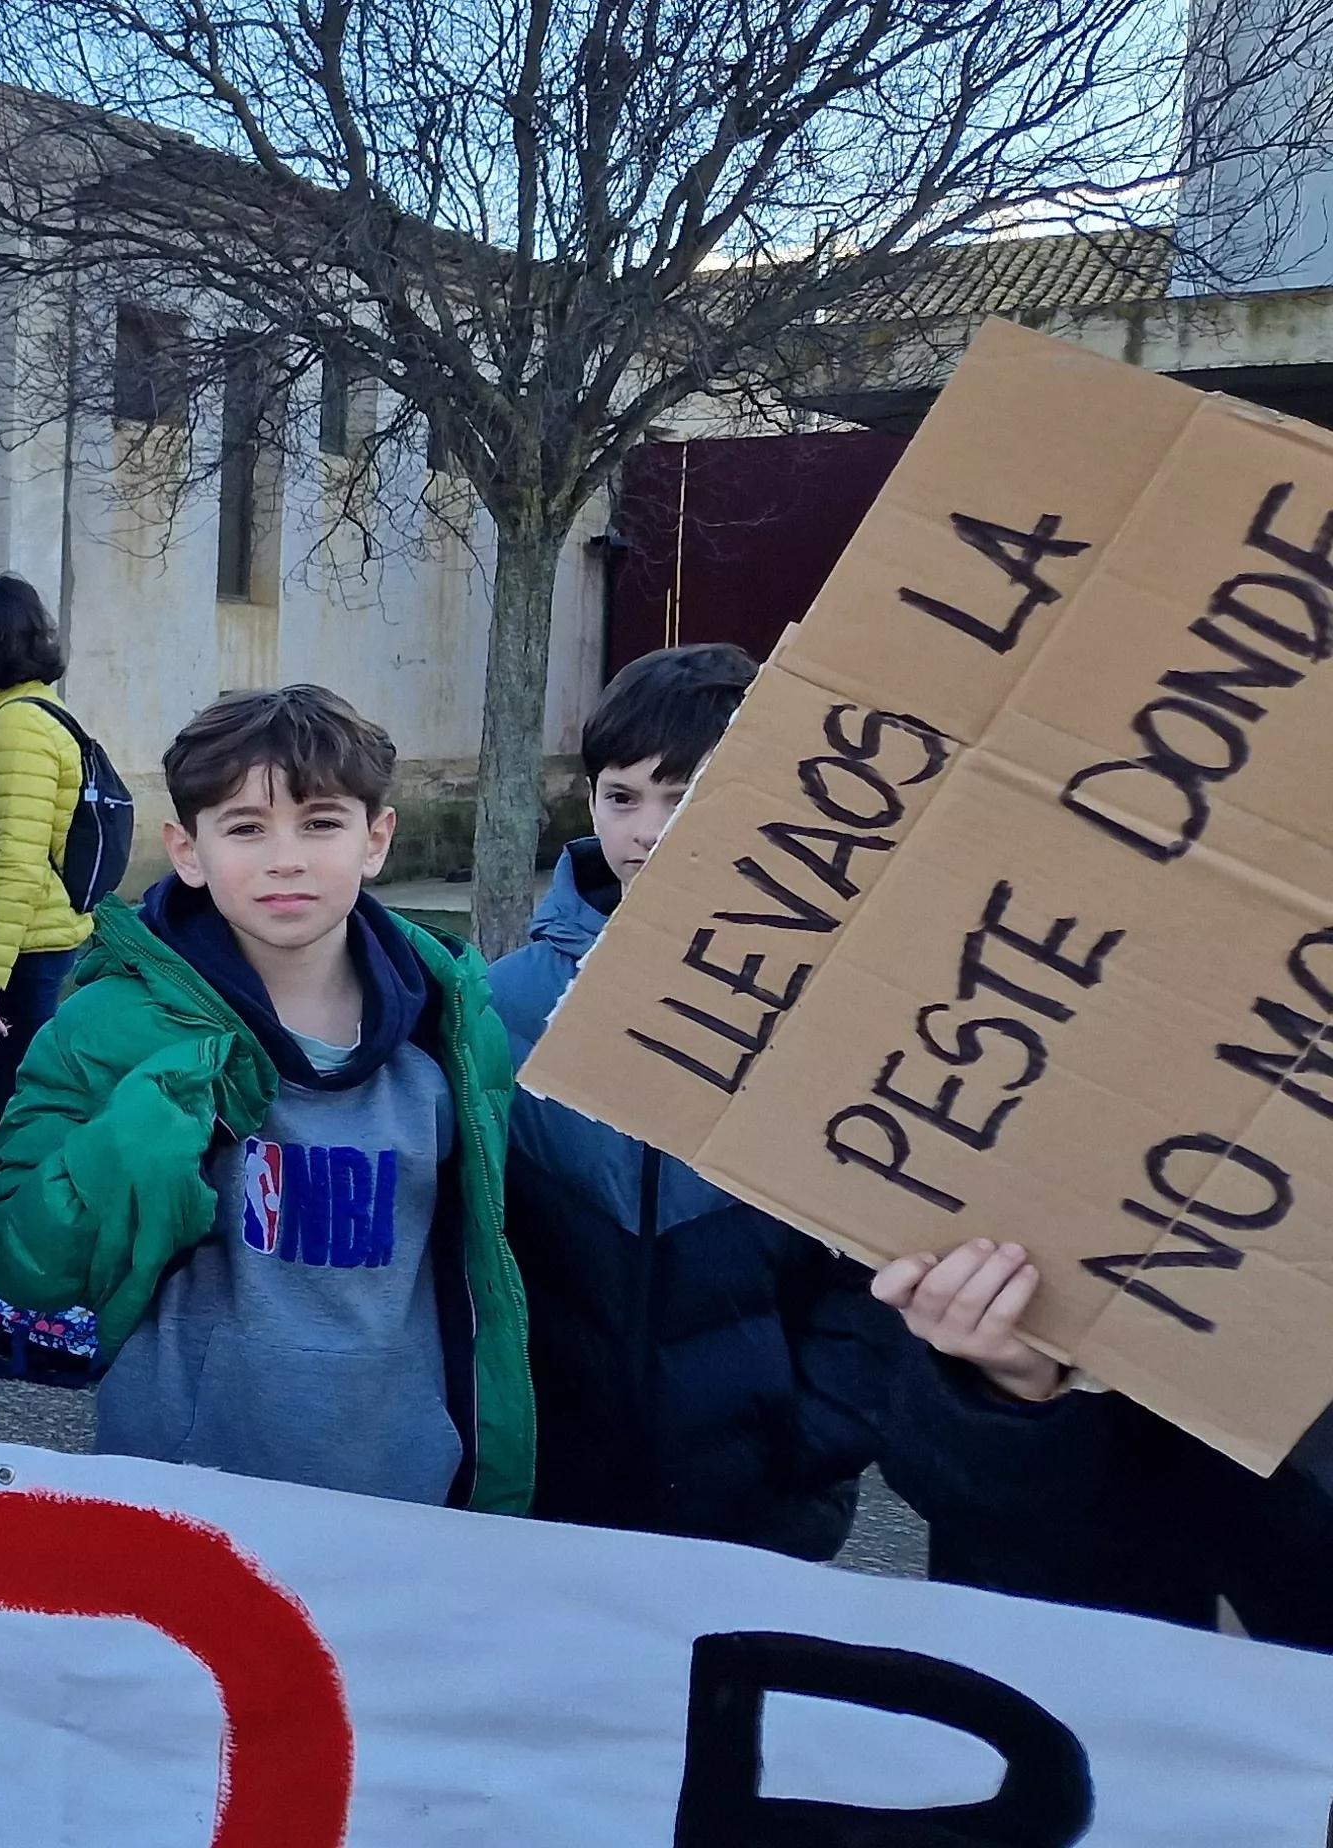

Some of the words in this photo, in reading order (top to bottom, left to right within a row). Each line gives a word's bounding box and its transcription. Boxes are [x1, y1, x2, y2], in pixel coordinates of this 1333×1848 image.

[625, 701, 950, 1095] LLEVAOS
[899, 512, 1092, 655] LA
[824, 879, 1127, 1213] PESTE
[1060, 481, 1333, 864] DONDE
[1079, 1132, 1294, 1333] NO
